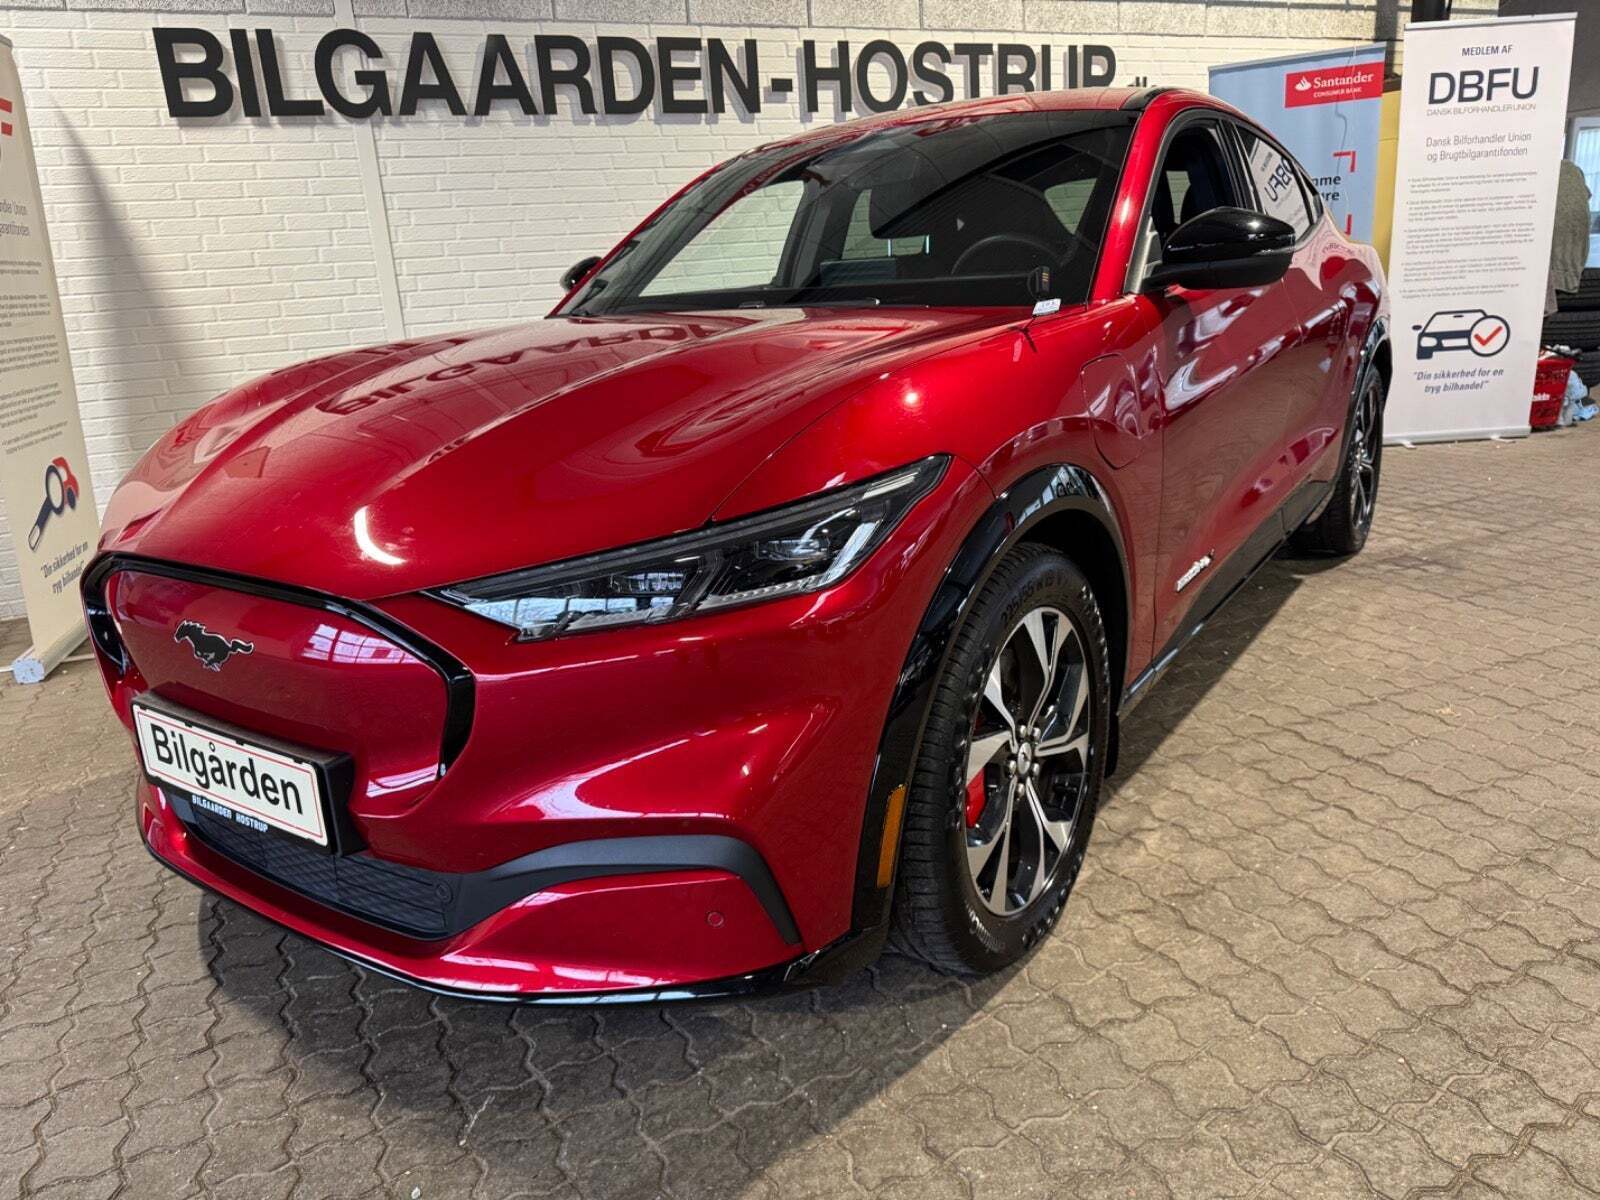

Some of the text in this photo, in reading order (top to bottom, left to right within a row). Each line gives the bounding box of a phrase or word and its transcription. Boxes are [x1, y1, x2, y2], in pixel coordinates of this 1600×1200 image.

[1462, 44, 1513, 57] MEDLEM AF
[1313, 71, 1374, 89] Santander
[1428, 66, 1540, 105] DBFU
[1313, 86, 1362, 98] CONSUMER BANK
[1426, 103, 1537, 117] DANSK BILFORHANDLER UNION
[1426, 131, 1532, 148] Dansk Bilforhandler Union
[1427, 147, 1528, 163] og Brugtbilgarantifonden
[1433, 369, 1476, 380] sikkerhed
[1478, 368, 1490, 377] for
[1492, 368, 1504, 377] en
[1424, 384, 1441, 394] tryg
[150, 723, 304, 815] Bilgården
[235, 812, 269, 833] HOSTRUP
